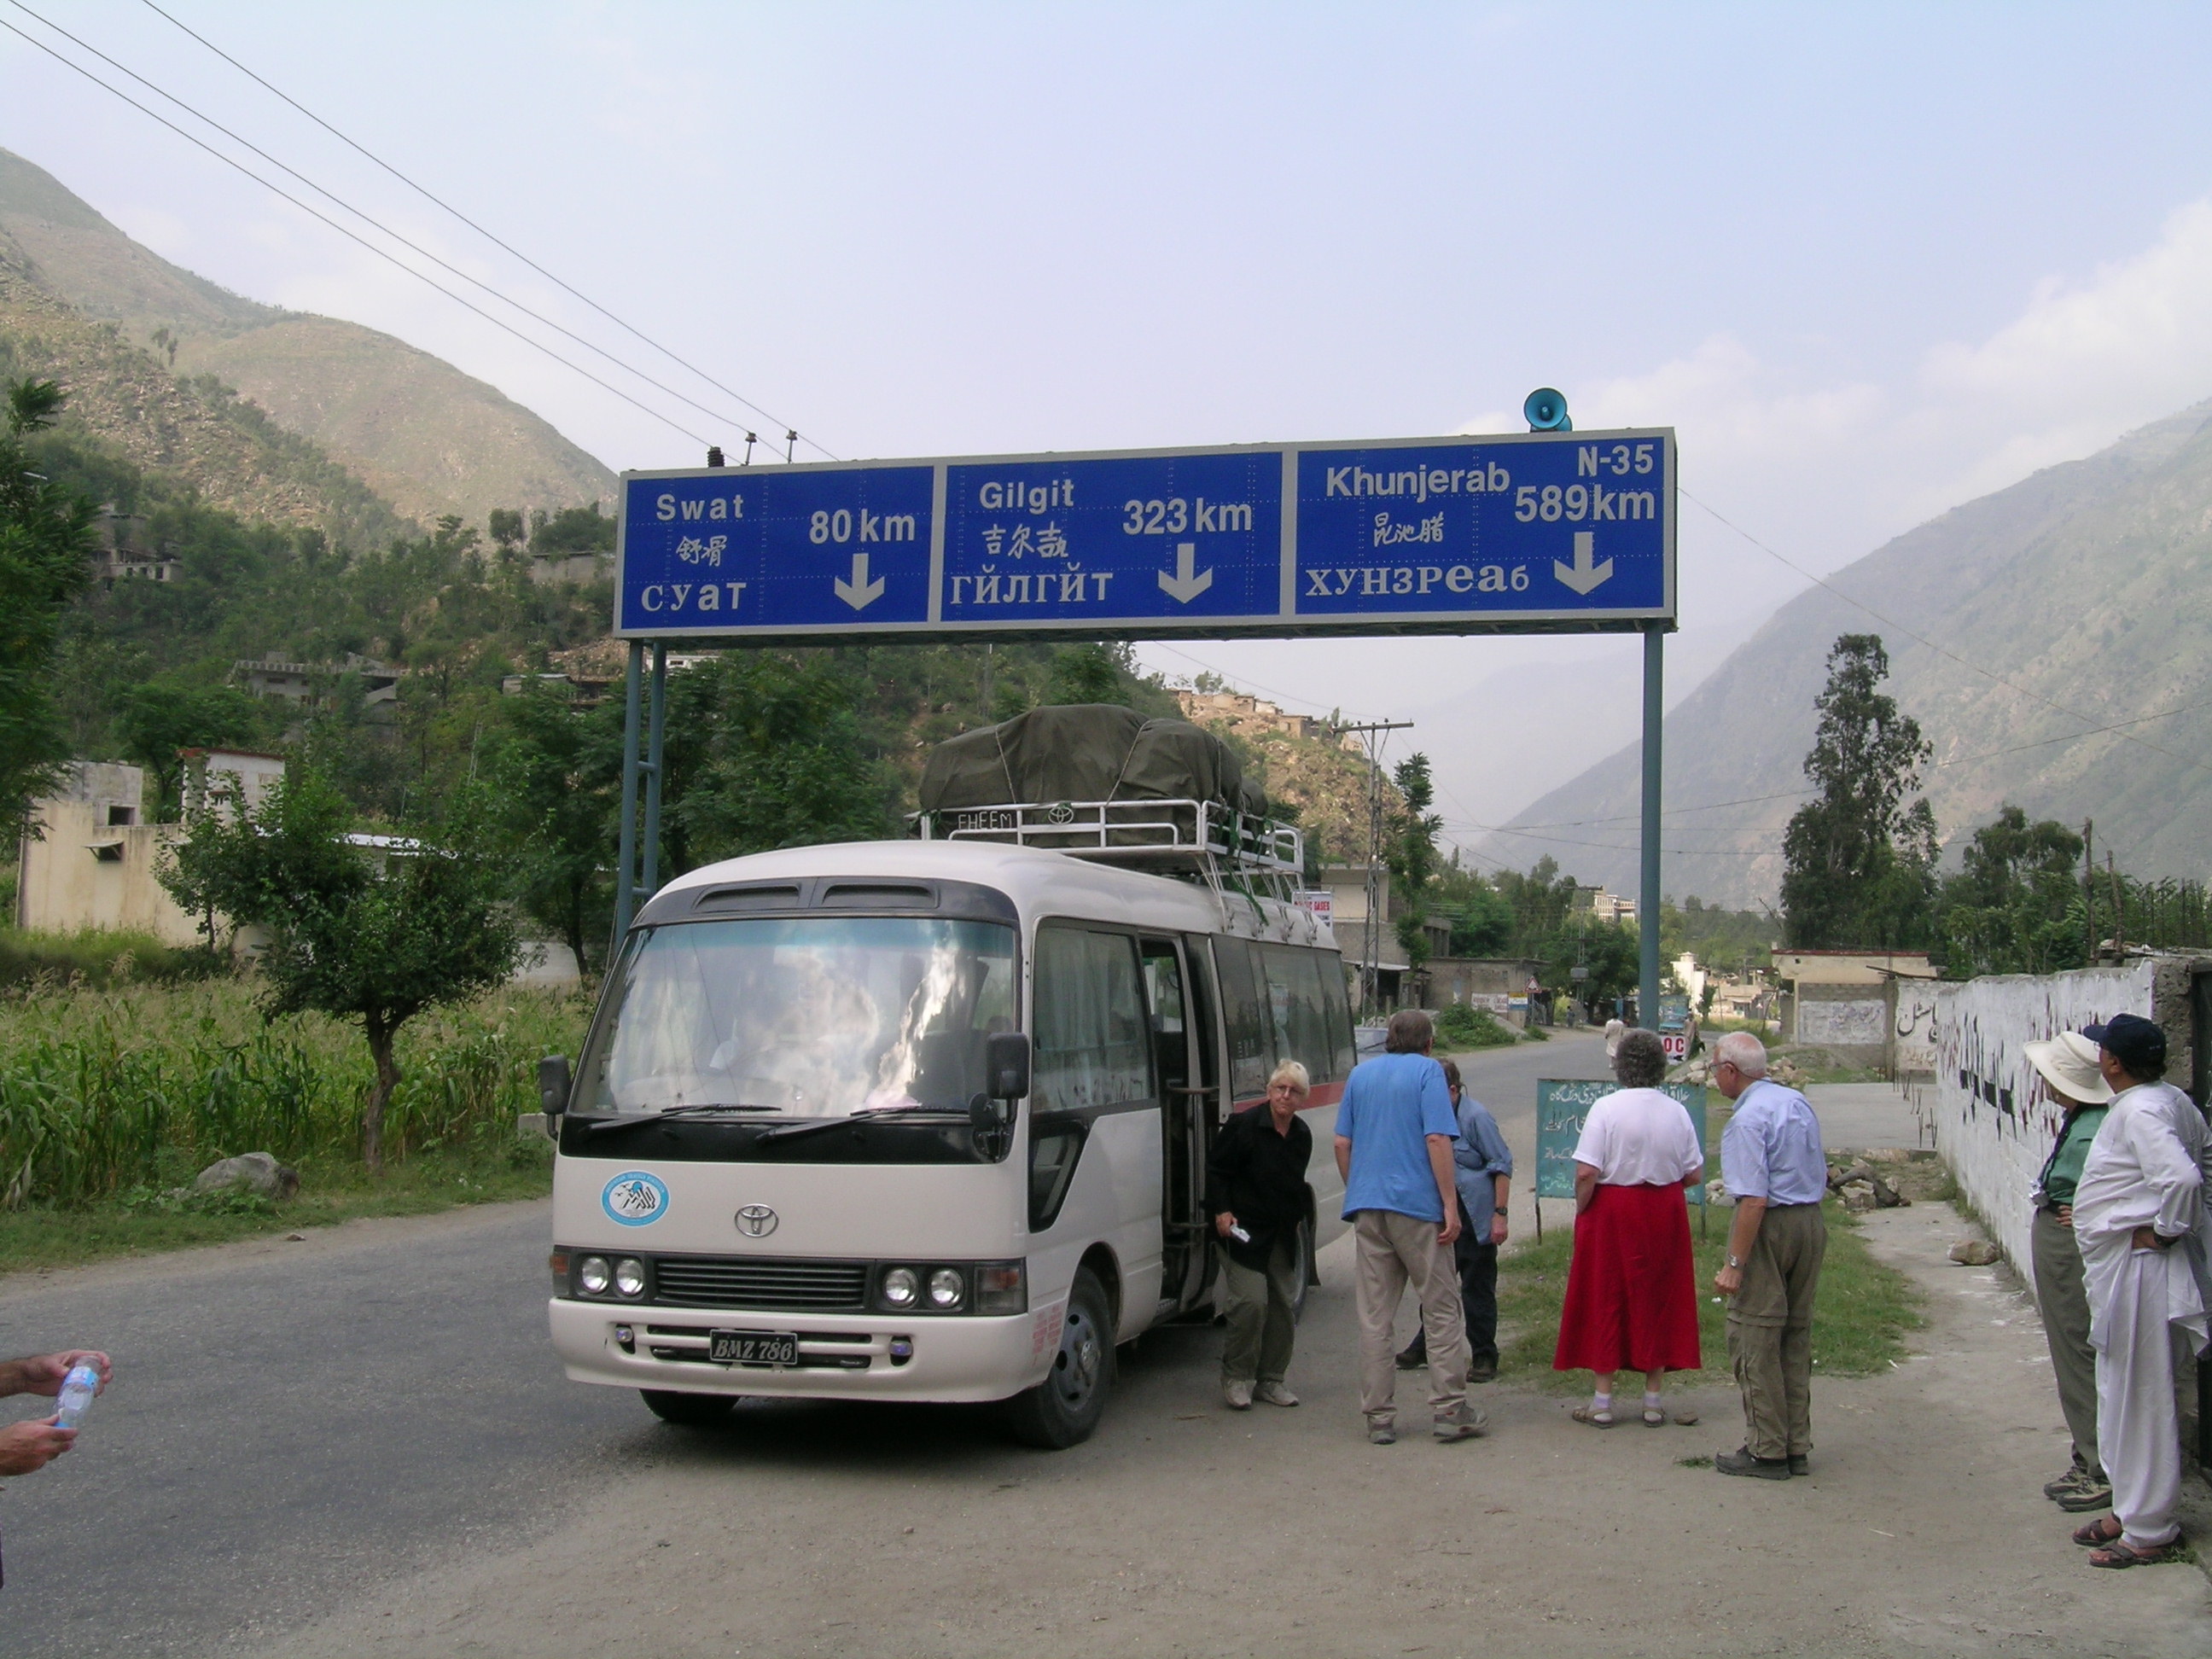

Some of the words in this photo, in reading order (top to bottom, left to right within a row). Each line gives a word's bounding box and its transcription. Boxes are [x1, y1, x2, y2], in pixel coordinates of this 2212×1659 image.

[1578, 444, 1654, 477] N-35
[980, 479, 1074, 515] Gilgit
[1327, 462, 1510, 504] Khunjerab
[656, 494, 743, 521] Swat
[713, 1339, 755, 1359] BMZ
[759, 1341, 794, 1361] 786
